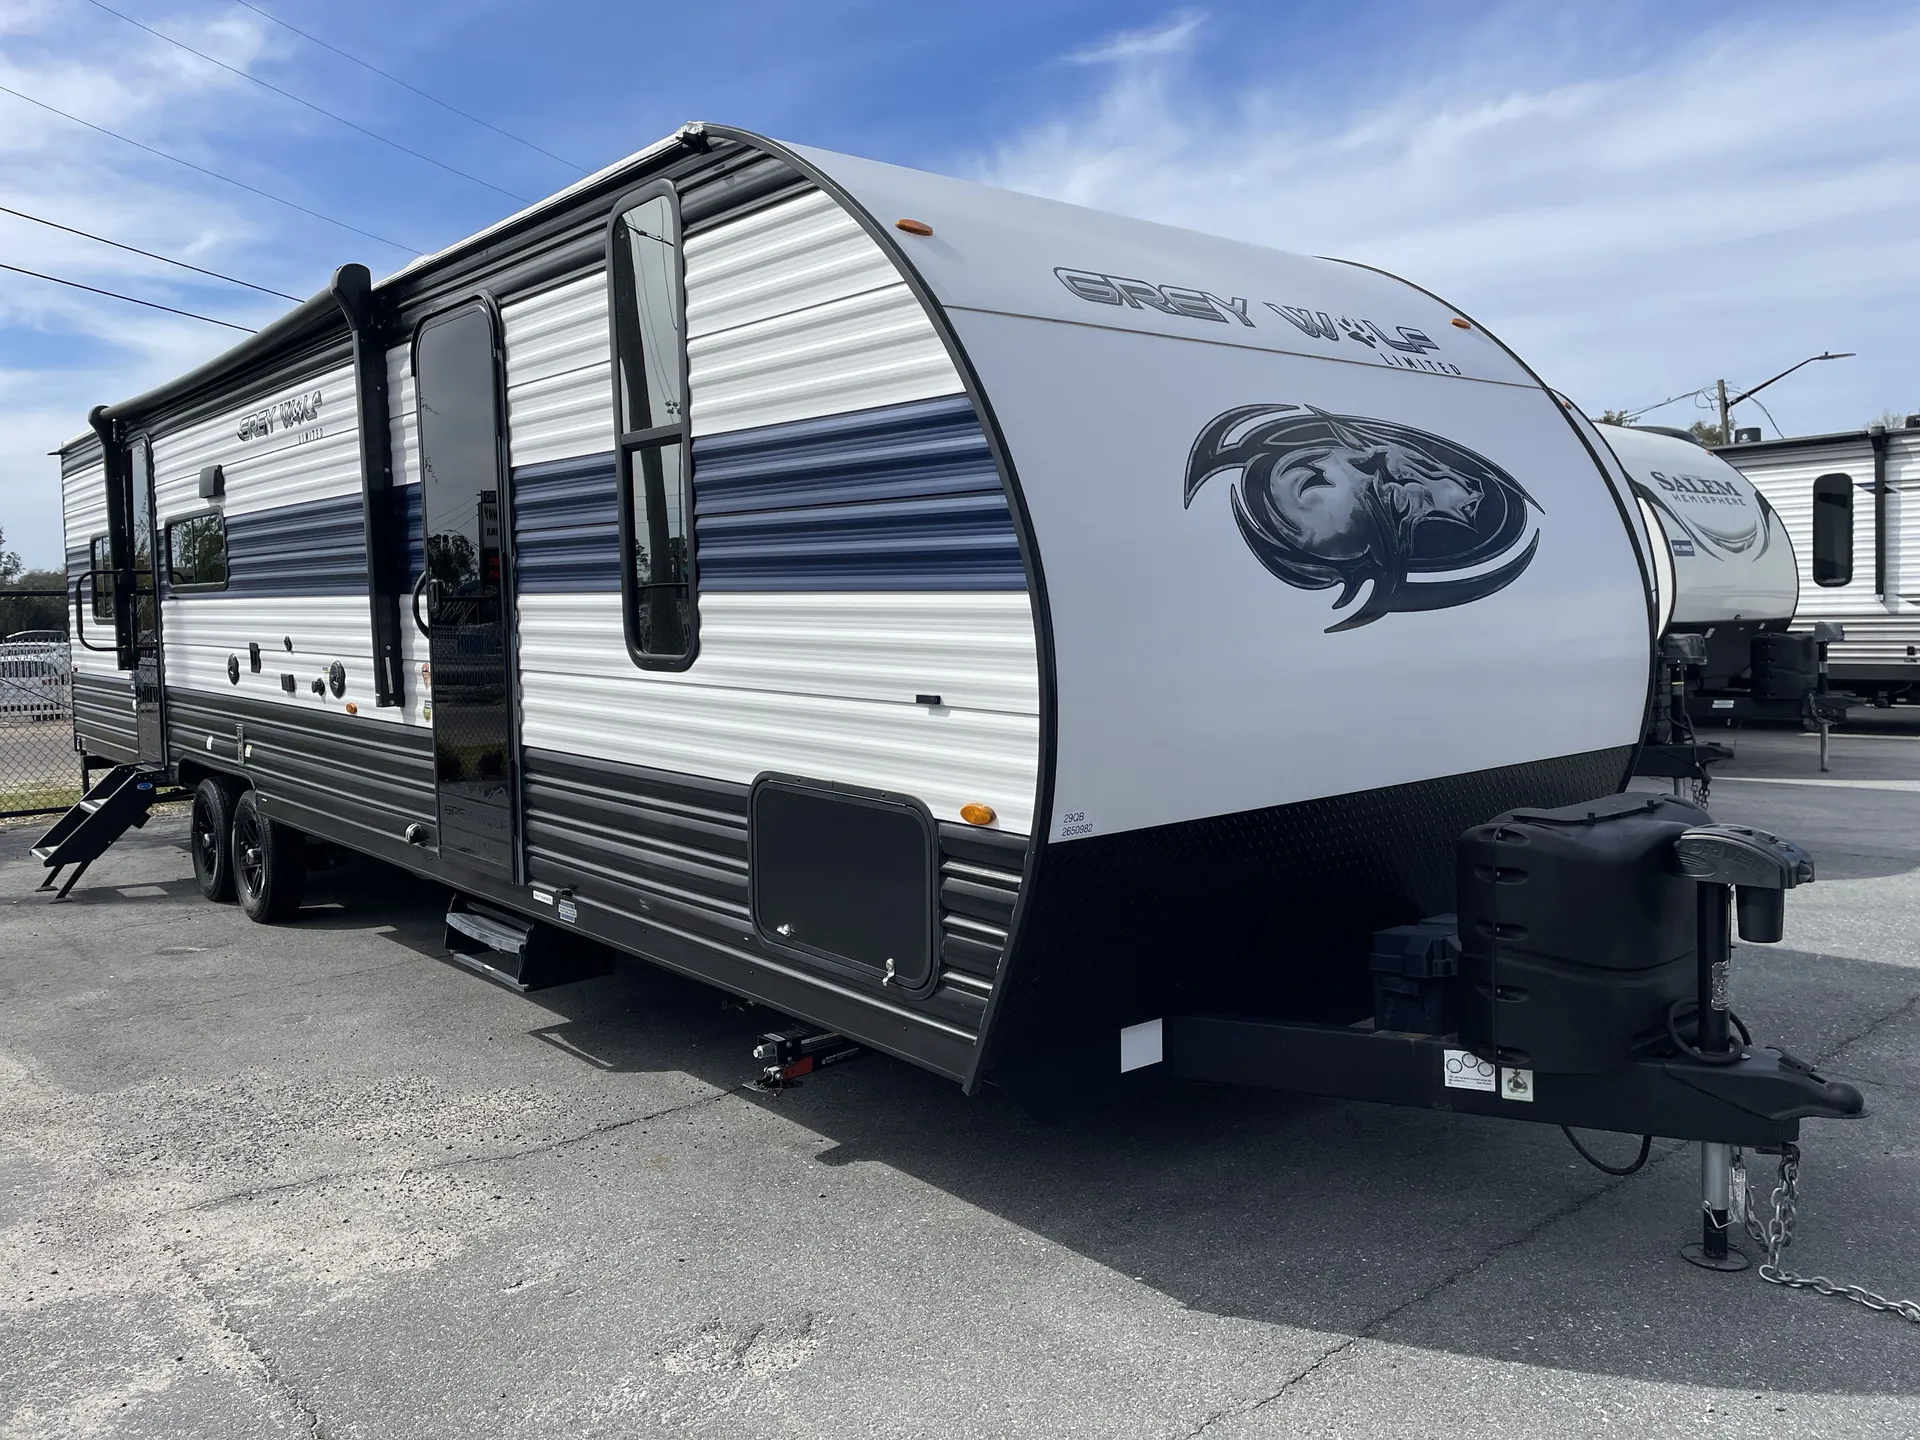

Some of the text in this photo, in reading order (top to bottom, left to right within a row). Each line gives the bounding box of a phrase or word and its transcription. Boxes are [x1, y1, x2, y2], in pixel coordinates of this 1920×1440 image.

[1053, 266, 1256, 328] GREY
[1380, 353, 1461, 376] LIMITED
[237, 406, 276, 442] GREY
[1650, 471, 1743, 496] SALEM
[1671, 493, 1746, 506] HEMISPHERE
[1062, 823, 1093, 836] 2650982
